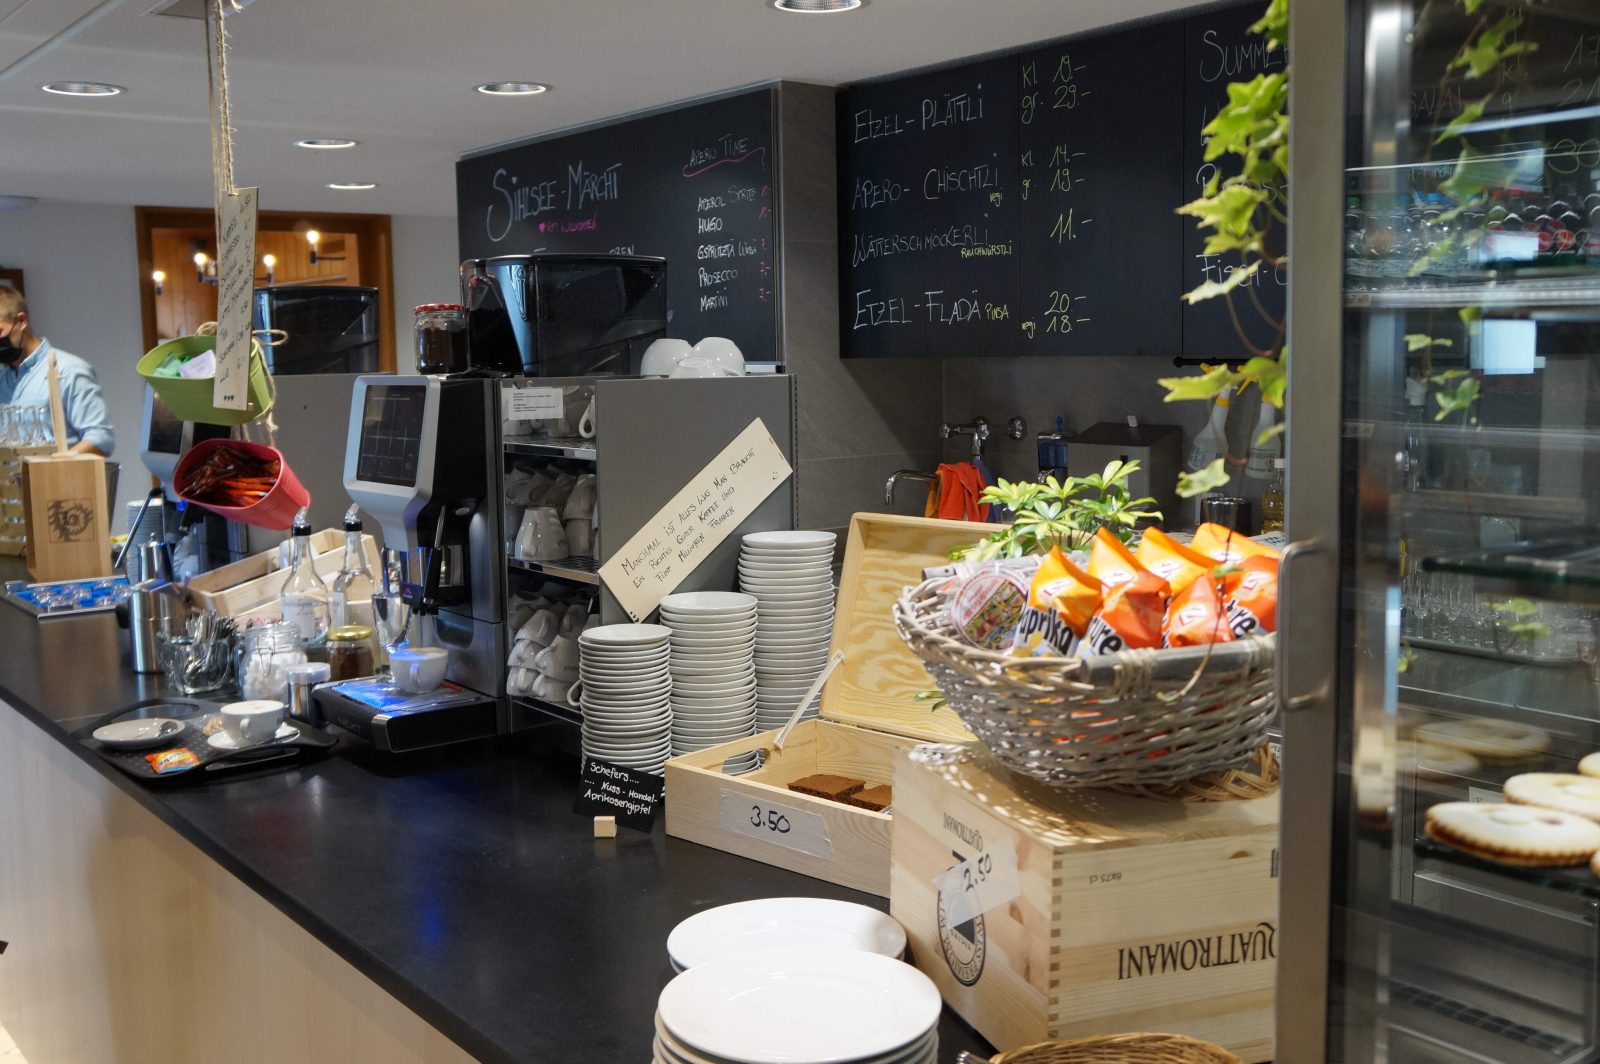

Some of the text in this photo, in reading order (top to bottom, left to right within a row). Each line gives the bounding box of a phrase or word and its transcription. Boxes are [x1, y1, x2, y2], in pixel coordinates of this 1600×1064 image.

[698, 217, 723, 234] HUGO
[698, 267, 738, 288] PROSECCO
[584, 788, 651, 816] Aprikosengipfel
[750, 805, 791, 835] 3.50
[963, 853, 992, 892] 2.50
